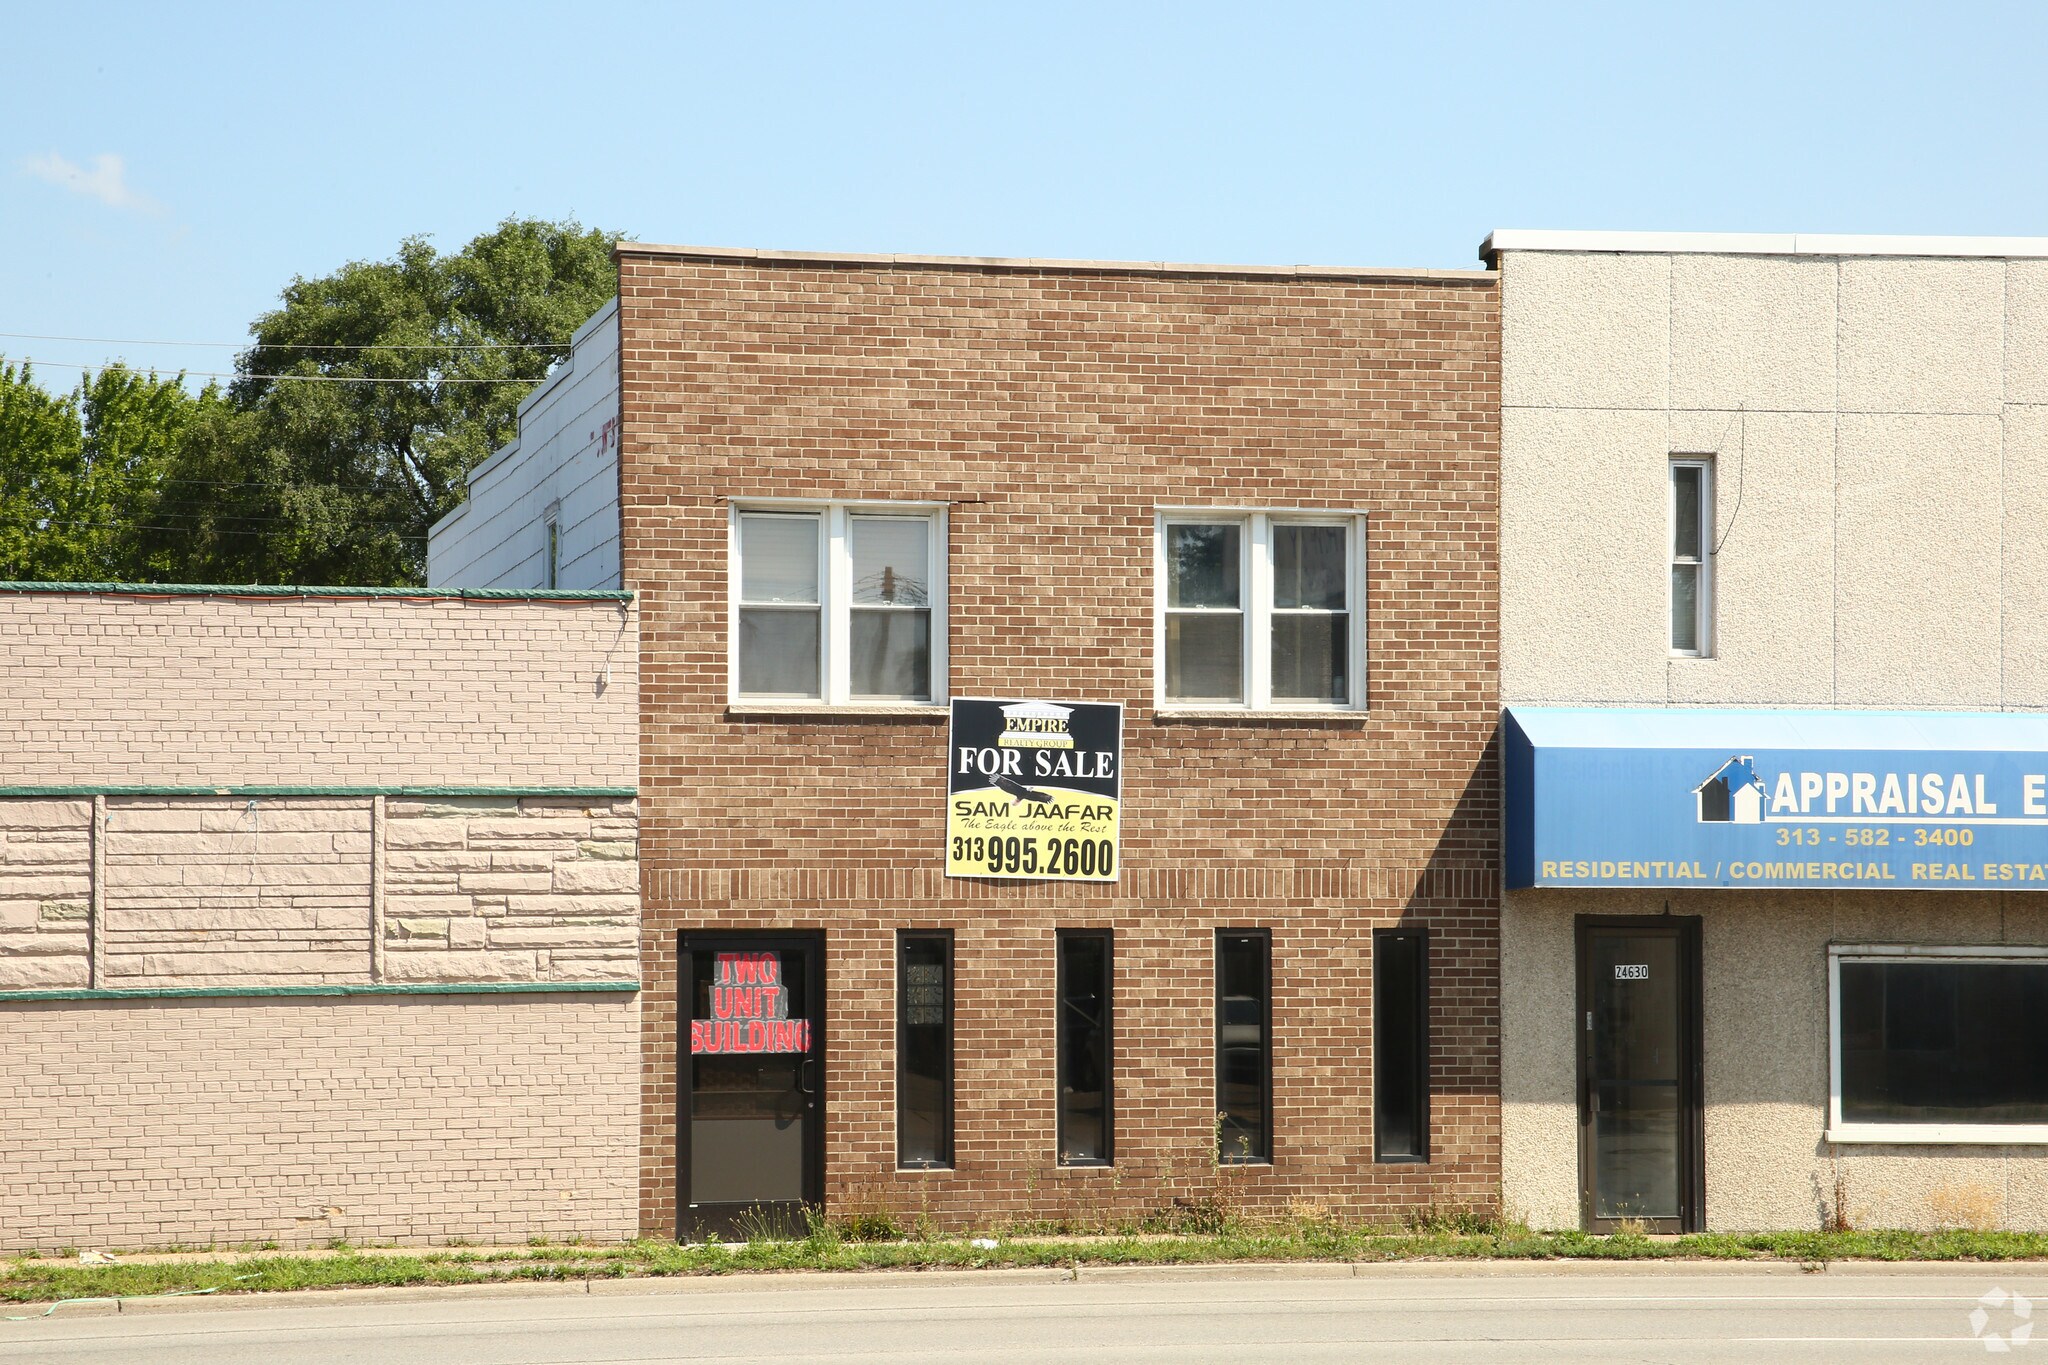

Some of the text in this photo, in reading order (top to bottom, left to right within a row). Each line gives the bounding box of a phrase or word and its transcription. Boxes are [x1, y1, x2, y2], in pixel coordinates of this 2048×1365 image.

[1005, 717, 1070, 733] EMPIRE
[1003, 738, 1068, 748] REALTY GROUP
[957, 746, 1114, 779] FOR SALE
[1771, 772, 1997, 814] APPRAISAL
[955, 801, 1113, 821] SAM JAAFAR
[960, 818, 1107, 833] The Eagle above the Rest
[1776, 828, 1821, 846] 313
[1845, 828, 1890, 846] 582
[1914, 828, 1974, 847] 3400
[953, 836, 1113, 877] 313 995.2600
[1541, 861, 1707, 879] RESIDENTIAL
[1729, 862, 1896, 880] COMMERCIAL
[1912, 863, 1976, 880] REAL
[718, 952, 777, 984] TWO
[1616, 966, 1648, 978] 24630
[714, 986, 780, 1018] UNIT
